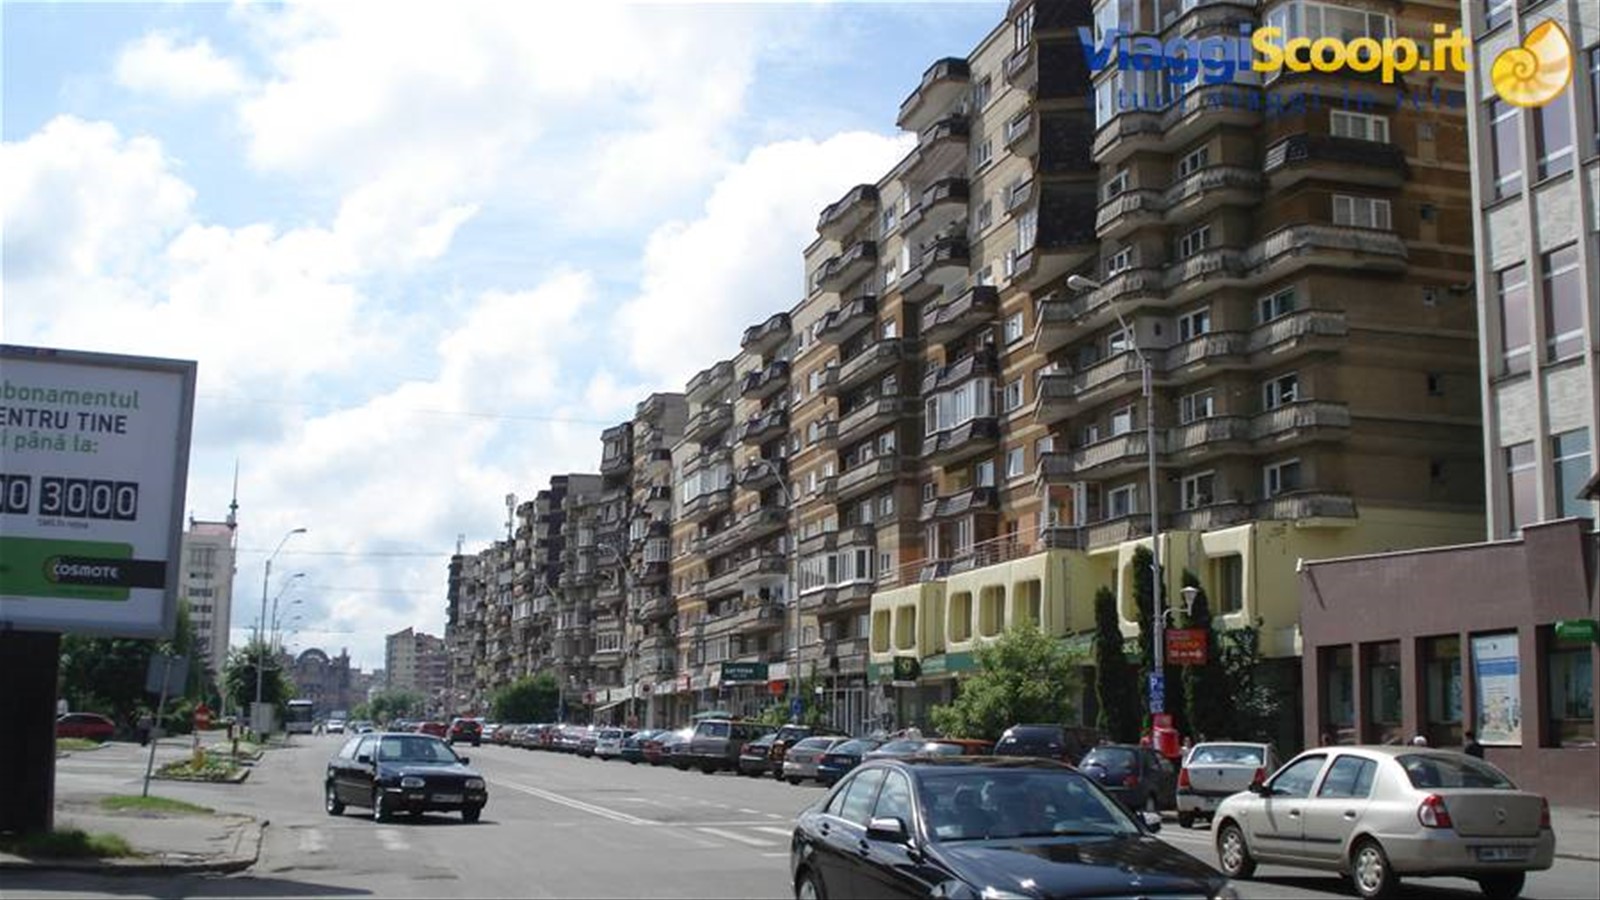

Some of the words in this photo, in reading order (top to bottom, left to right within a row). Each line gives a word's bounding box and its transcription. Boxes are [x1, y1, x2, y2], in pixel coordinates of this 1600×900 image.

[0, 380, 140, 409] bonamentul
[77, 411, 128, 435] TINE
[42, 482, 137, 516] 3000
